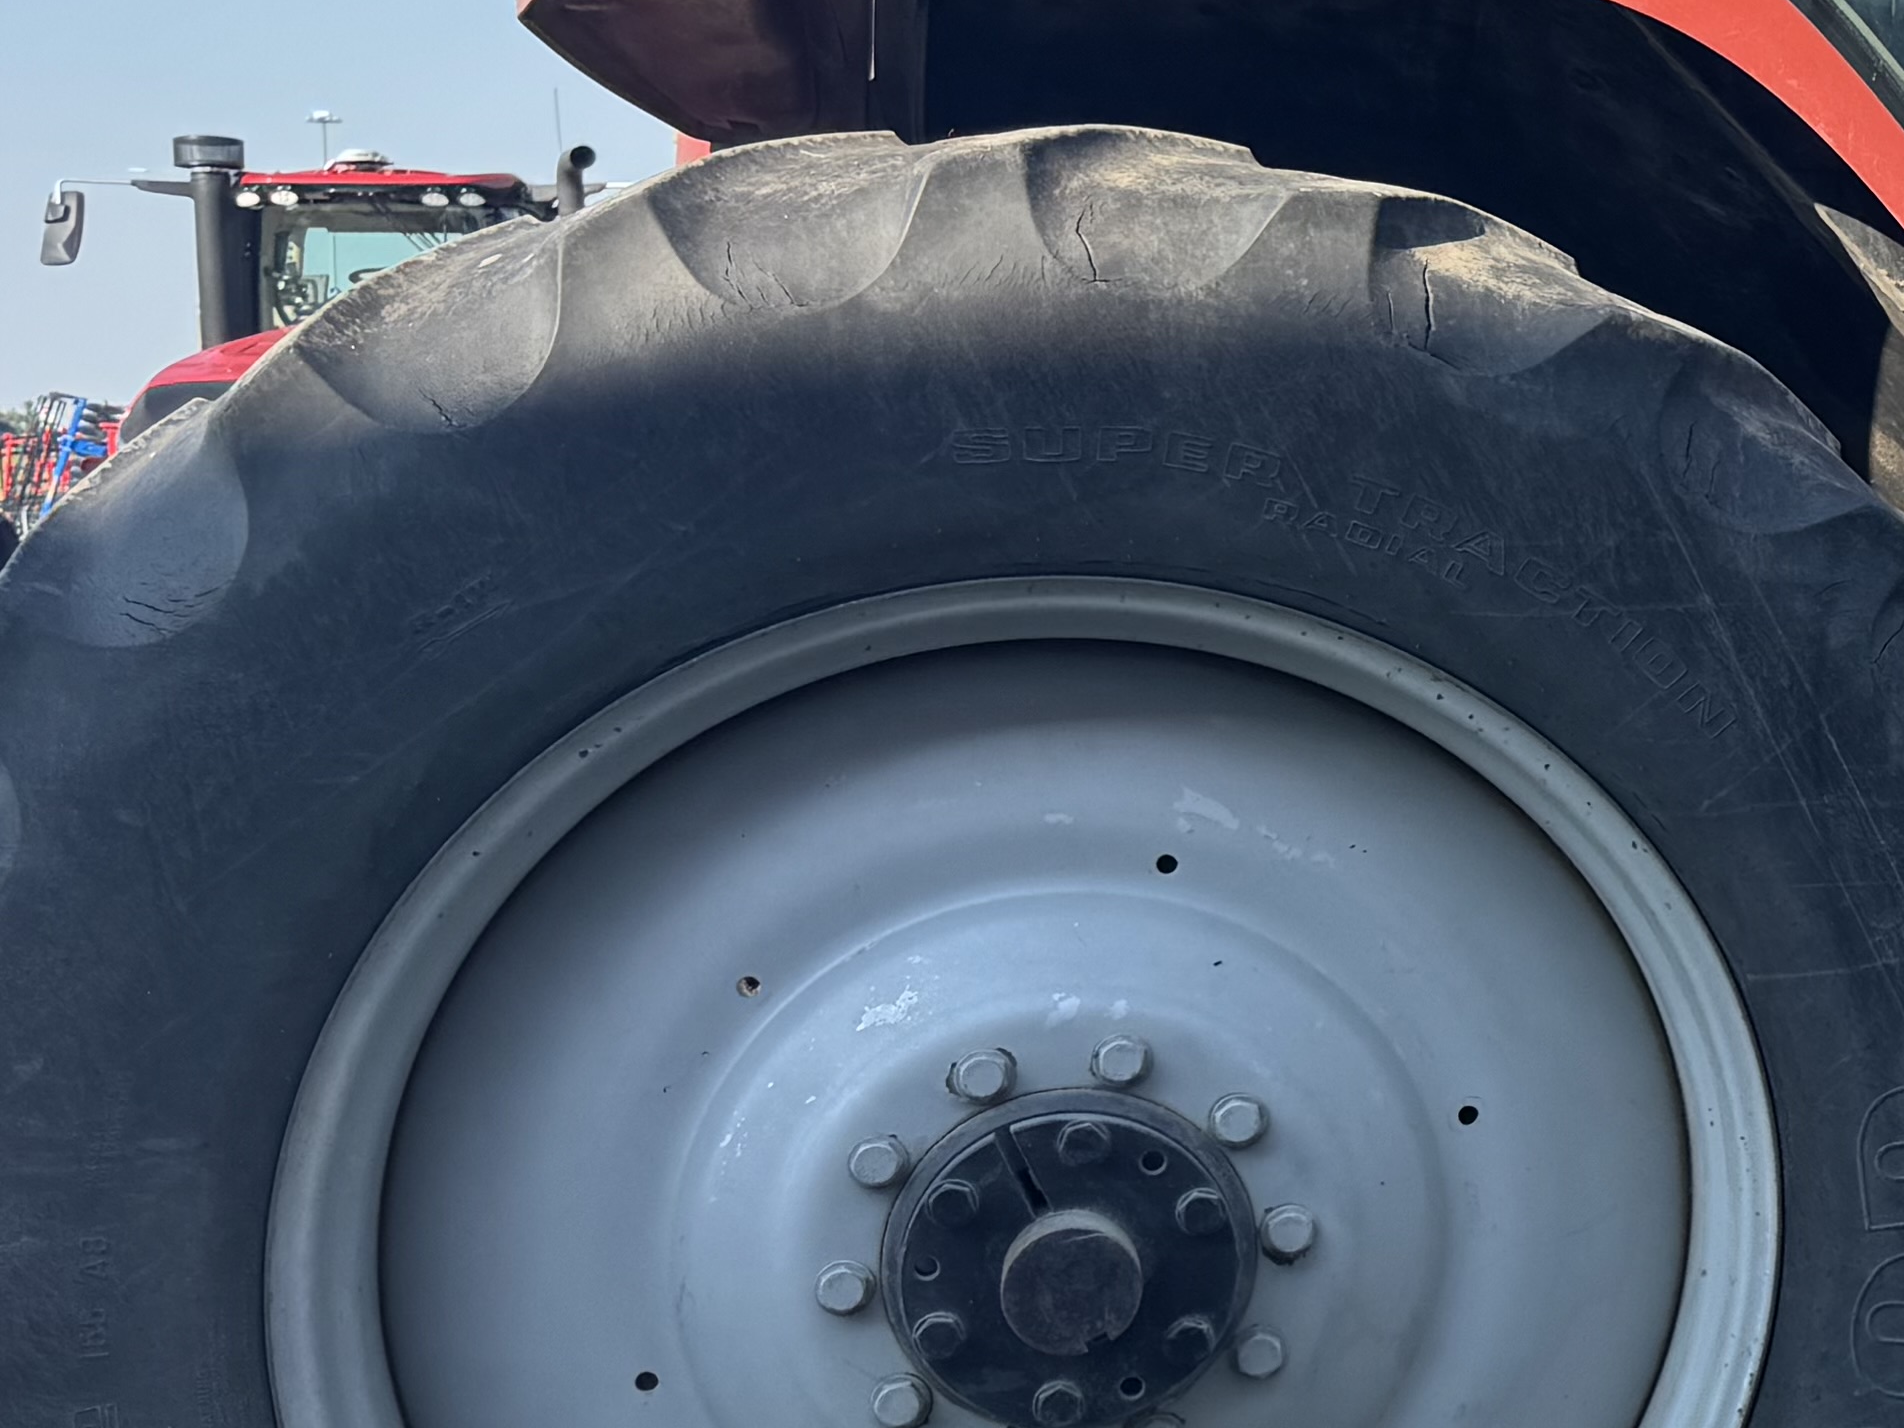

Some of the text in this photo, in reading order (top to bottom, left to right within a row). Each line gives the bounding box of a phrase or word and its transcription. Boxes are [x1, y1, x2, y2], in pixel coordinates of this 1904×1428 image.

[951, 425, 1738, 740] SUPER TRACTION
[1263, 496, 1472, 592] RADIAL
